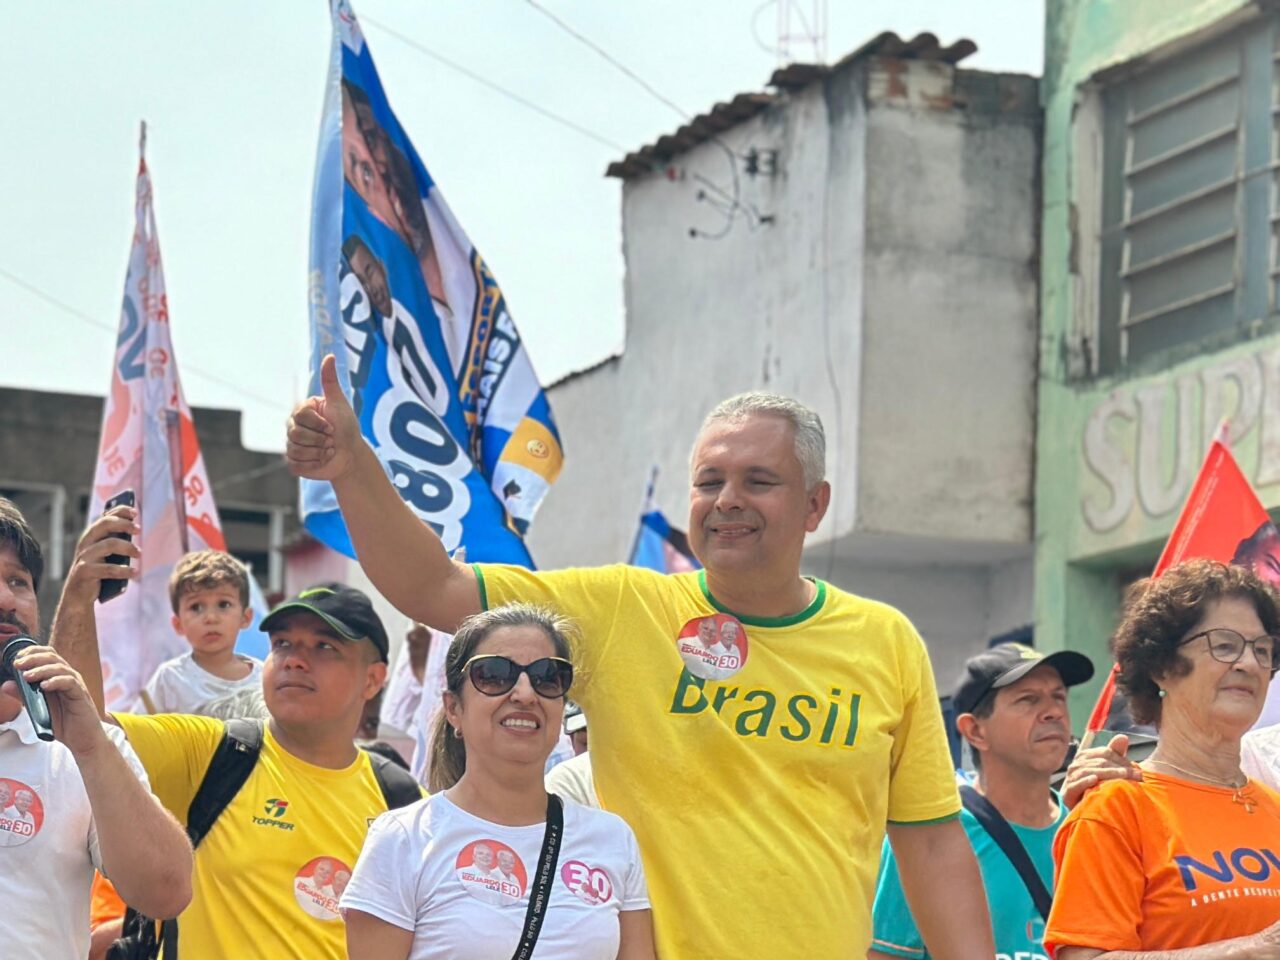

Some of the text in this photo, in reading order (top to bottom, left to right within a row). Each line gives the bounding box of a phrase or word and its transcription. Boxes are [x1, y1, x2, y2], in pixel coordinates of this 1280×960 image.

[720, 655, 738, 669] 30
[670, 664, 861, 746] Brasil
[14, 821, 31, 836] 30
[252, 815, 295, 831] TOPPER
[570, 864, 609, 899] 30
[501, 882, 520, 897] 30
